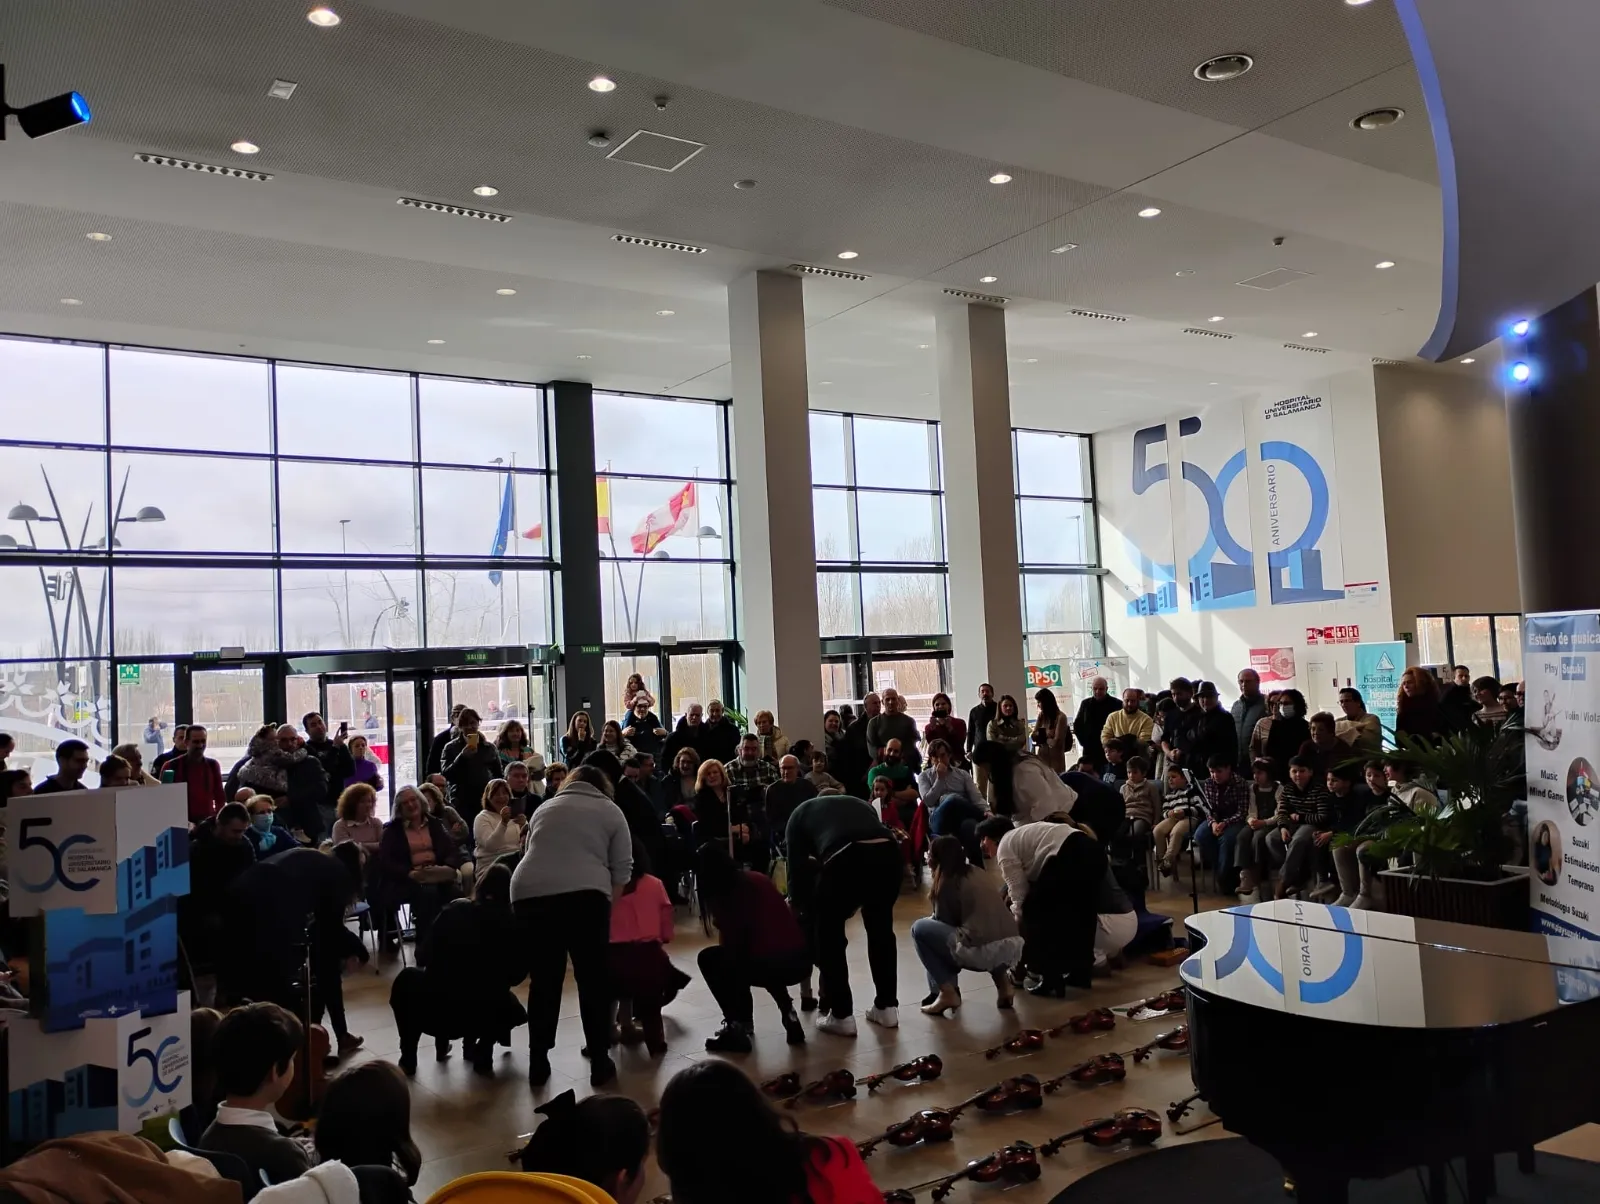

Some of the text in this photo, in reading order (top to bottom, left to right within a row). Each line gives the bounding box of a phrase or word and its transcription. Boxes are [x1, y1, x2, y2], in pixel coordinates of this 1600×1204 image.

[1264, 397, 1322, 414] UNIVERSITARIO
[1274, 395, 1311, 407] HOSPITAL
[1273, 403, 1322, 418] SALAMANCA
[1266, 464, 1281, 546] ANIVERSARIO
[1528, 632, 1557, 646] Estudio
[1558, 631, 1569, 645] de
[1544, 663, 1585, 676] Play Suzuki
[1027, 670, 1059, 685] BPSO
[1363, 674, 1393, 683] hospital
[1583, 711, 1600, 723] Viola
[1541, 769, 1558, 781] Music
[1529, 786, 1565, 802] Mind Games
[1572, 836, 1590, 850] Suzuki
[1567, 874, 1595, 893] Temprana
[1571, 905, 1590, 922] Suzuki
